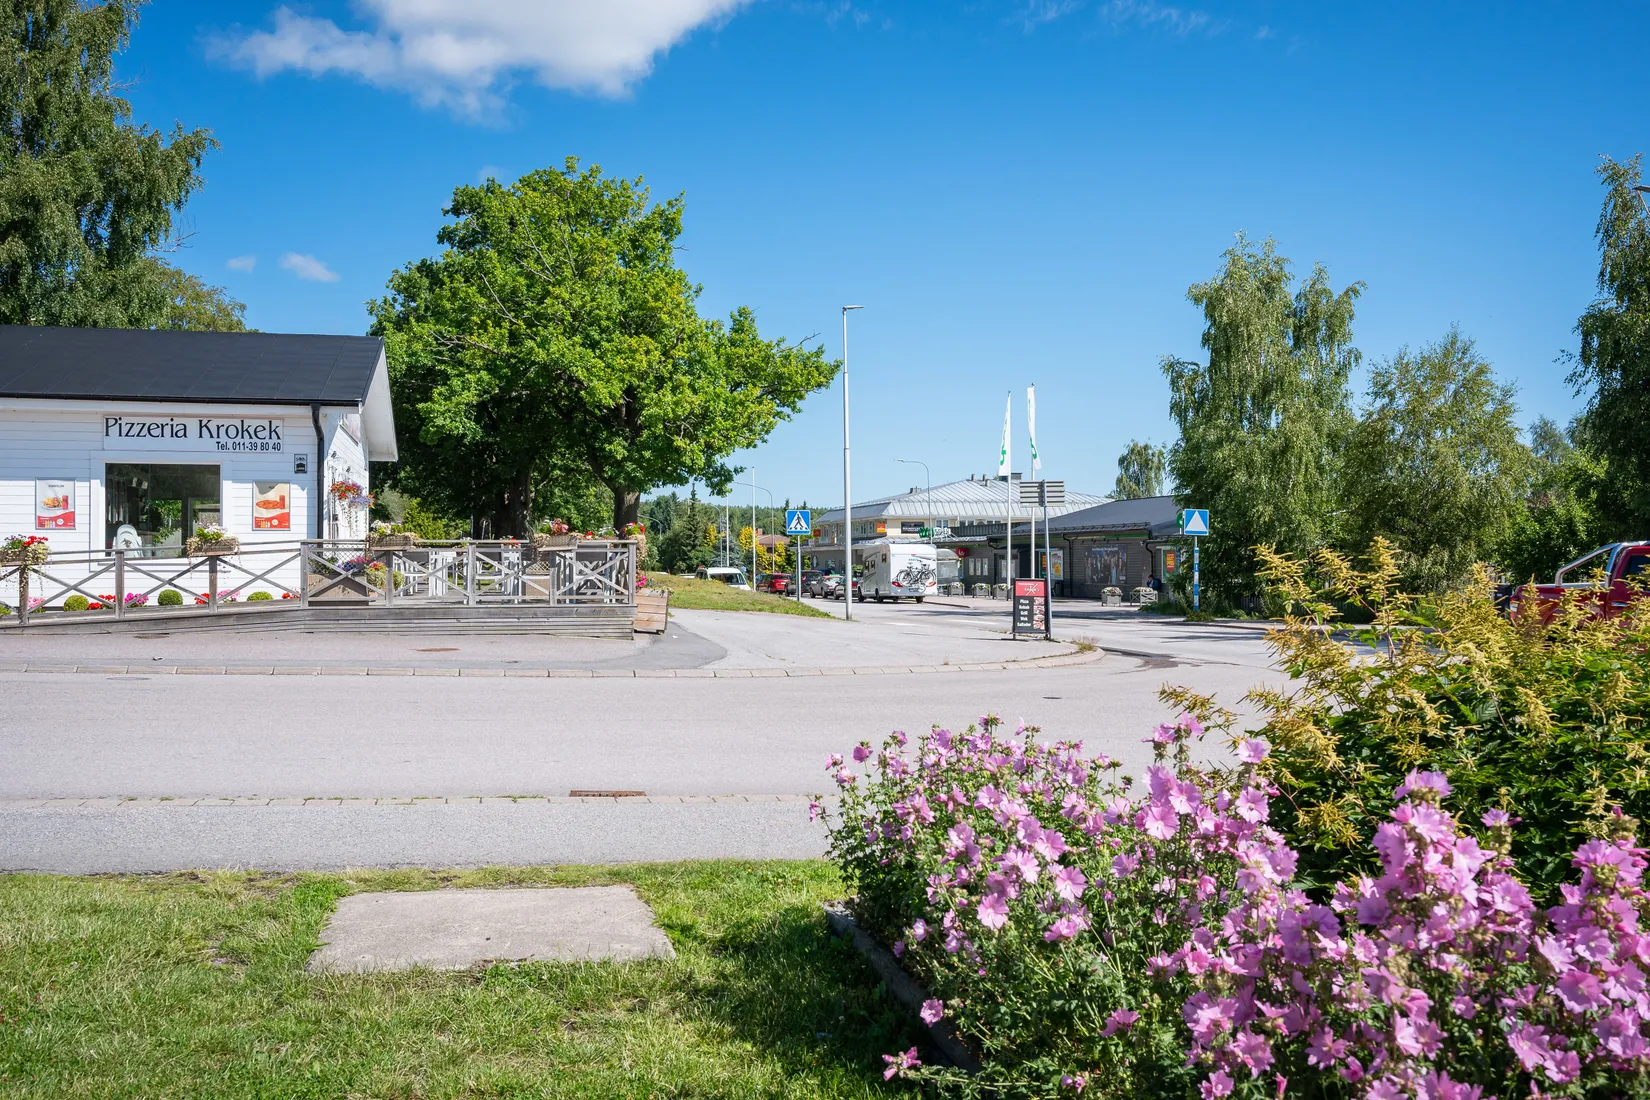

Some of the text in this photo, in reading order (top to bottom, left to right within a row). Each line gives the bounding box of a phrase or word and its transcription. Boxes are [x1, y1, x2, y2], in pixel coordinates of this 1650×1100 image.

[105, 417, 282, 440] Pizzeria Krokek
[216, 441, 281, 451] Tel. 011-39 80 40
